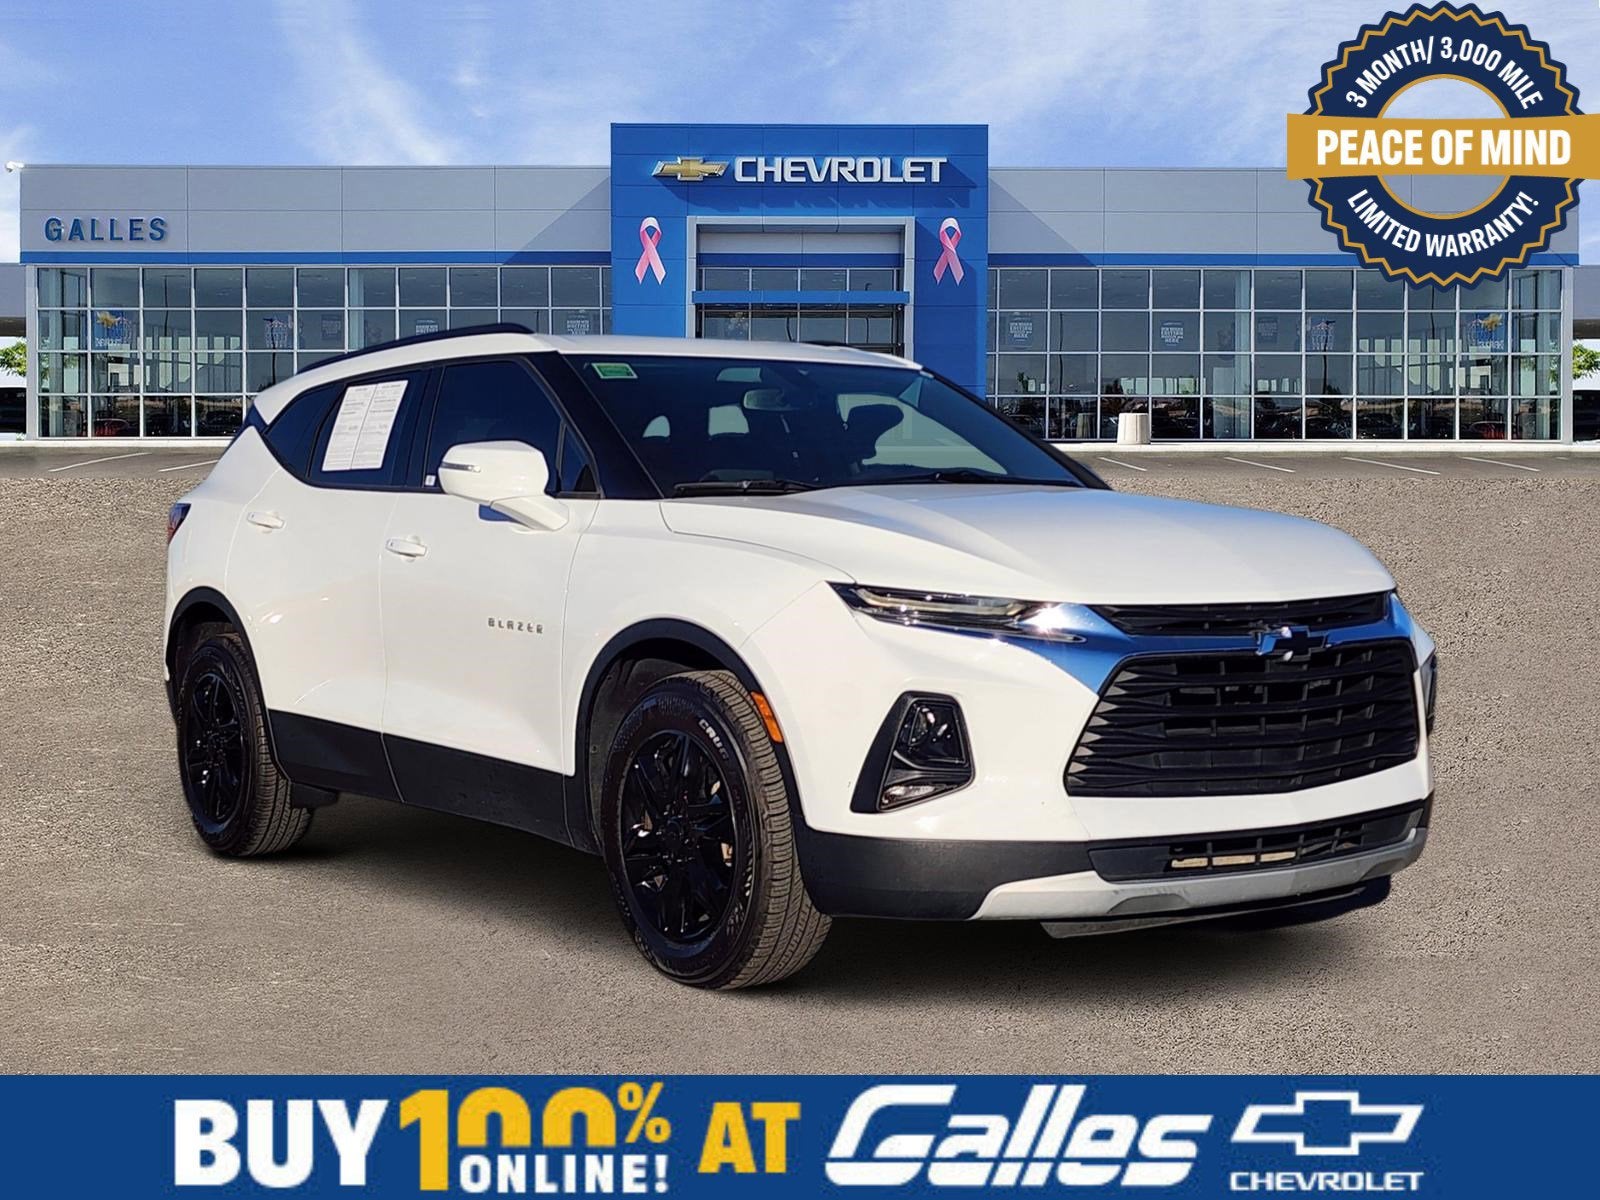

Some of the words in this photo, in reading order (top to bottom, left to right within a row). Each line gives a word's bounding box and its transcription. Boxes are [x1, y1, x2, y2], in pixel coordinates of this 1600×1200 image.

[734, 156, 948, 183] CHEVROLET
[44, 216, 168, 242] GALLES
[488, 617, 543, 634] BLAZER
